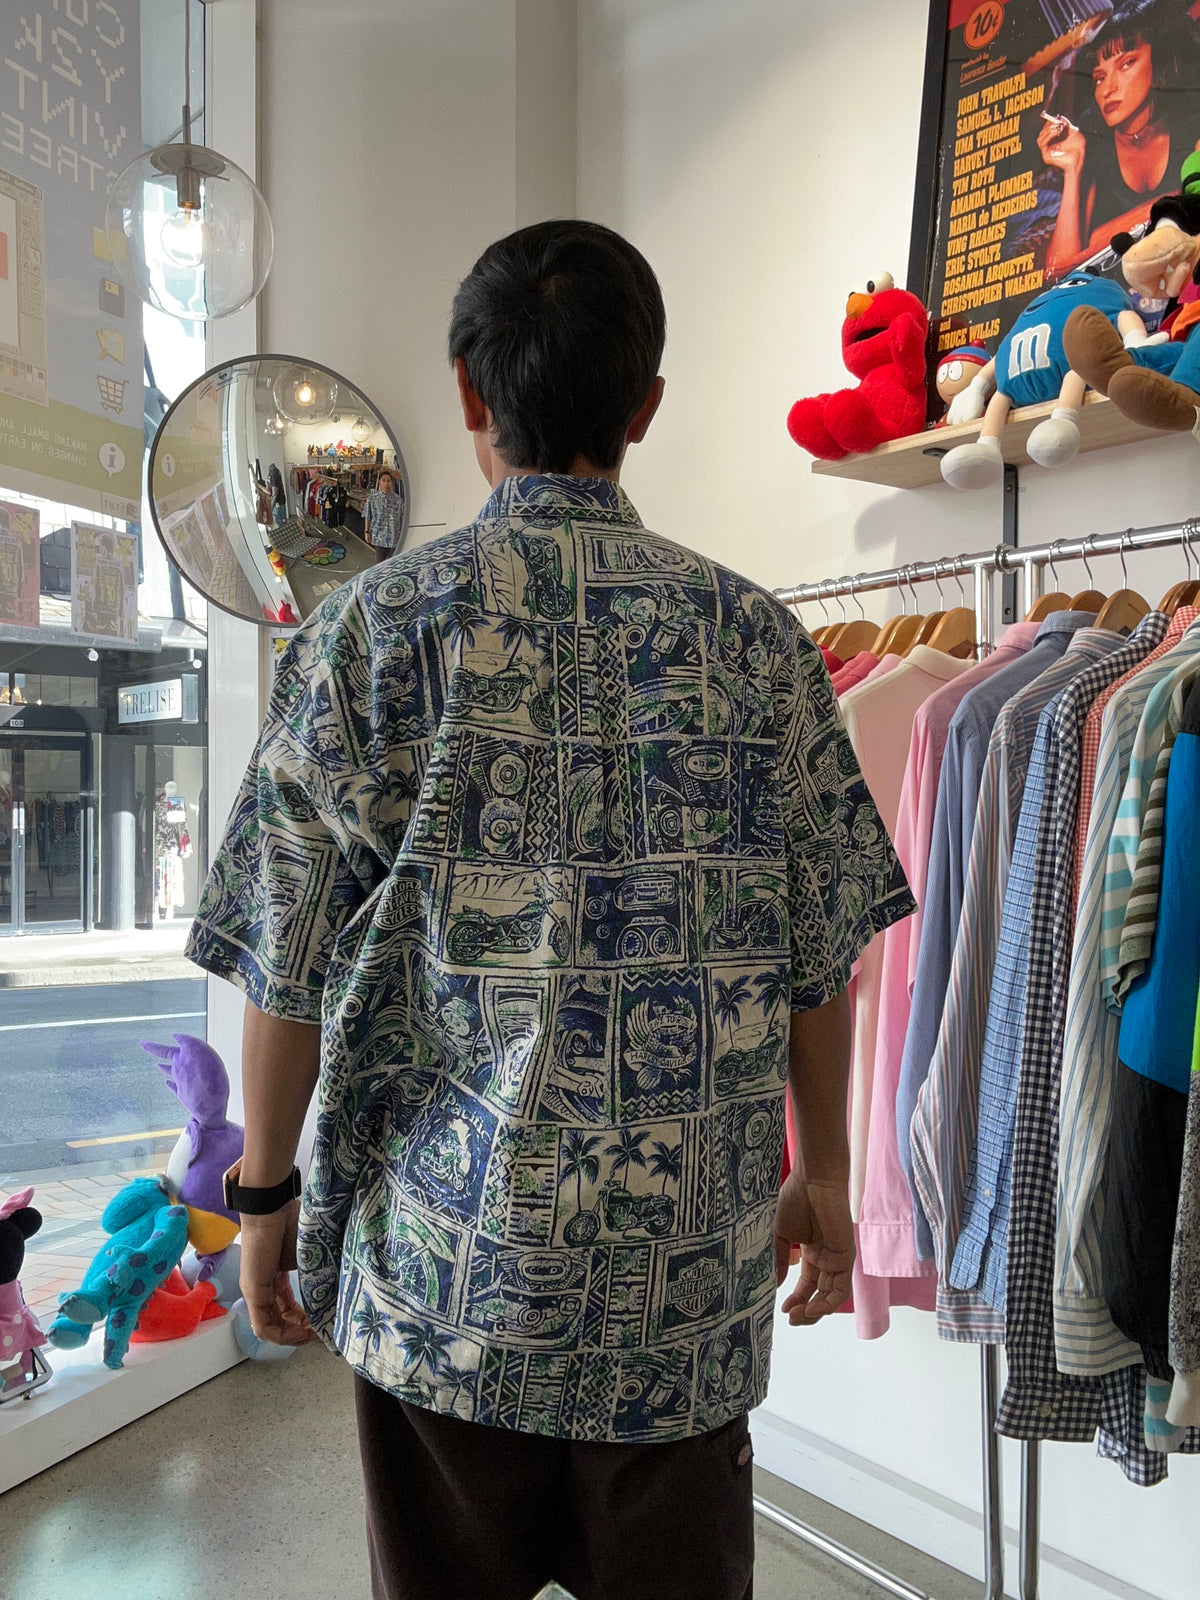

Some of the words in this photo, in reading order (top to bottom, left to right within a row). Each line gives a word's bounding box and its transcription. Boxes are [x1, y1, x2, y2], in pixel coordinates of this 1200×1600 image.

[956, 107, 992, 137] SAMUEL
[993, 104, 1002, 122] L.
[1004, 84, 1045, 117] JACKSON
[957, 92, 979, 118] JOHN
[981, 72, 1026, 106] TRAVOLTA
[954, 148, 988, 178] HARVEY
[989, 135, 1022, 164] KEITEL
[955, 134, 974, 157] UMA
[976, 115, 1021, 148] THURMAN
[950, 188, 986, 218] AMANDA
[988, 170, 1033, 203] PLUMMER
[953, 176, 969, 197] TIM
[970, 165, 995, 190] ROTH
[949, 212, 977, 238] MARIA
[979, 209, 989, 227] de
[991, 189, 1038, 223] MEDEIROS
[945, 255, 965, 278] ERIC
[967, 242, 1001, 271] STOLTZ
[947, 235, 968, 257] VING
[969, 221, 1006, 250] RHAMES
[941, 283, 1003, 318] CHRISTOPHER
[1005, 269, 1044, 298] WALKEN
[943, 269, 984, 298] ROSANNA
[985, 252, 1035, 284] ARQUETTE
[938, 327, 967, 352] BRUCE
[969, 318, 1000, 343] WILLIS
[940, 317, 951, 332] and
[1009, 323, 1051, 379] m
[124, 688, 175, 716] TRELISE
